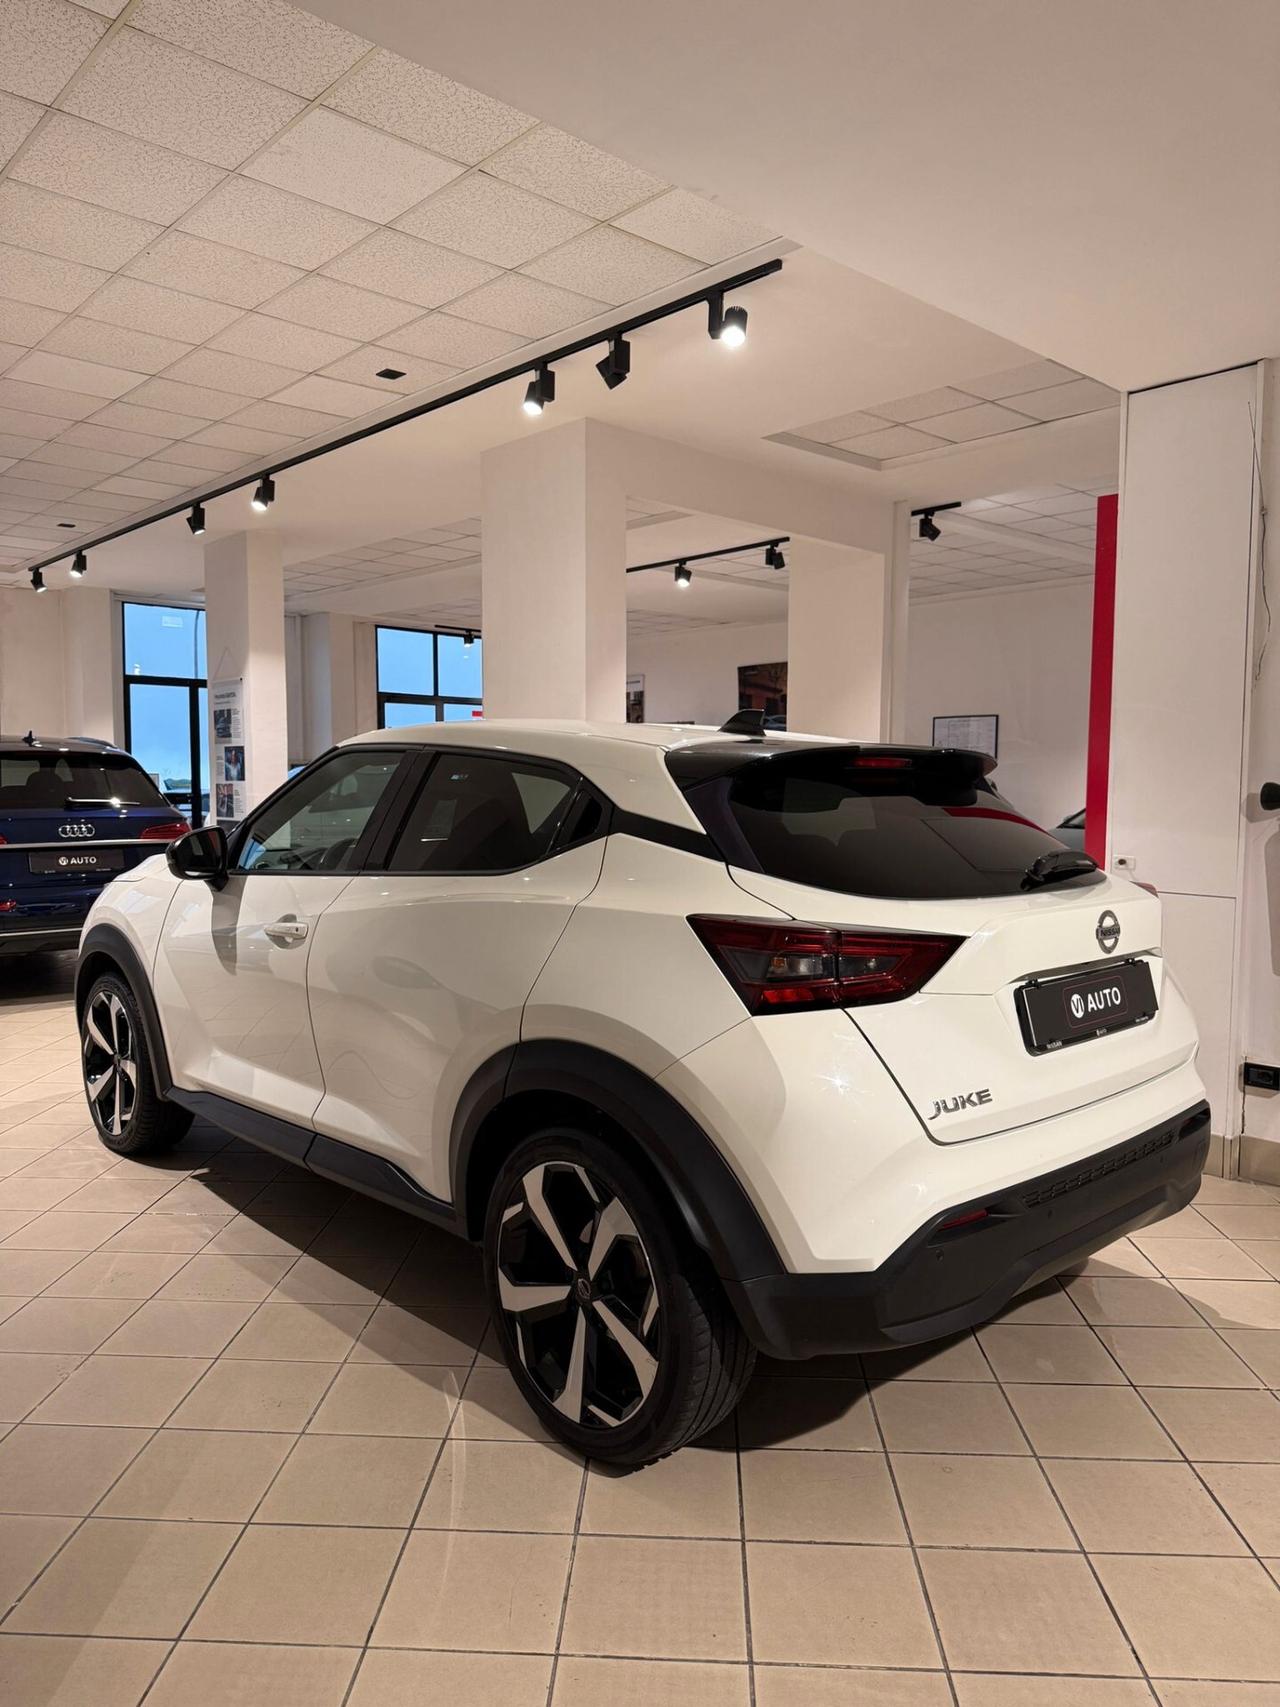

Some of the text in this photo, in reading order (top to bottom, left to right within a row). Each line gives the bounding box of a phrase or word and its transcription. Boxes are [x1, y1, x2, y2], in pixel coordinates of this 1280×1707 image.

[70, 856, 97, 865] AUTO
[1087, 986, 1121, 1013] AUTO
[927, 1087, 993, 1121] JUKE
